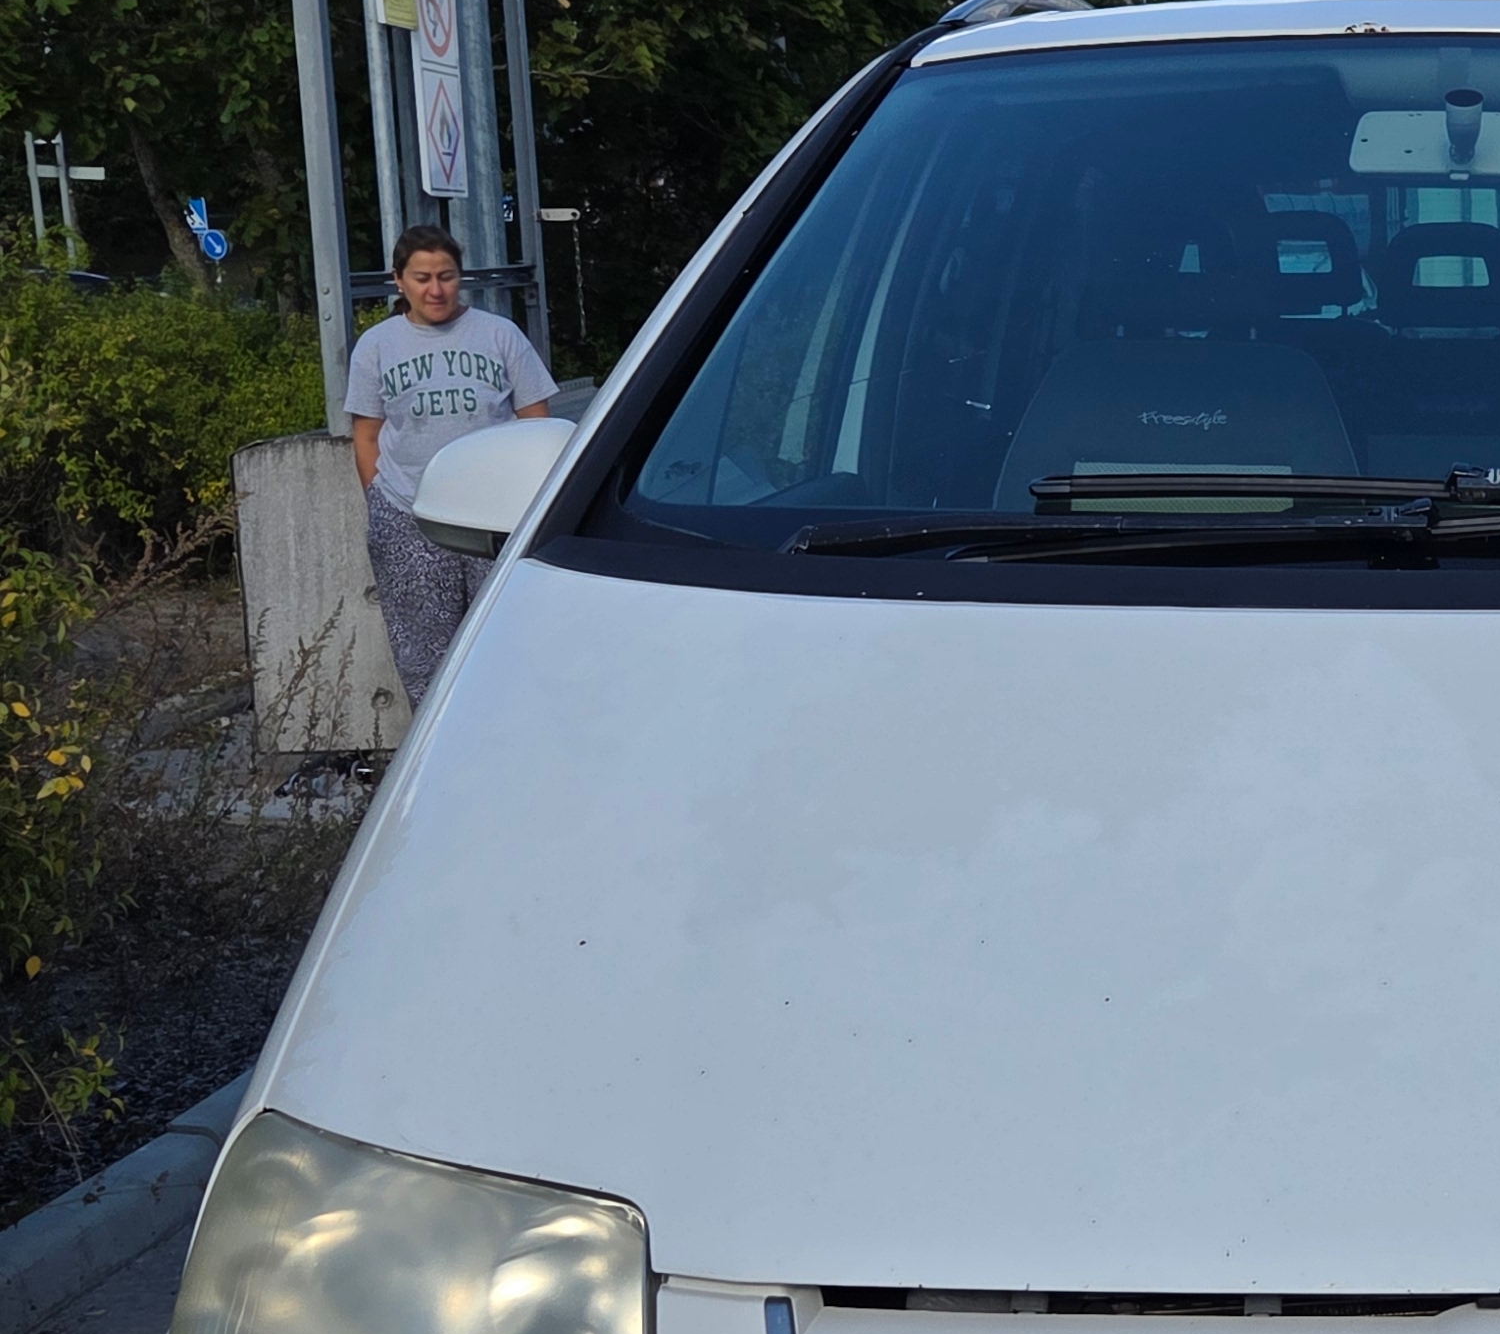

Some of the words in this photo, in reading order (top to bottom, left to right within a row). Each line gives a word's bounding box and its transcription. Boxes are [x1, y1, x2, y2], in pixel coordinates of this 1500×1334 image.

[383, 353, 434, 401] NEW
[442, 350, 503, 394] YORK
[411, 387, 477, 417] JETS
